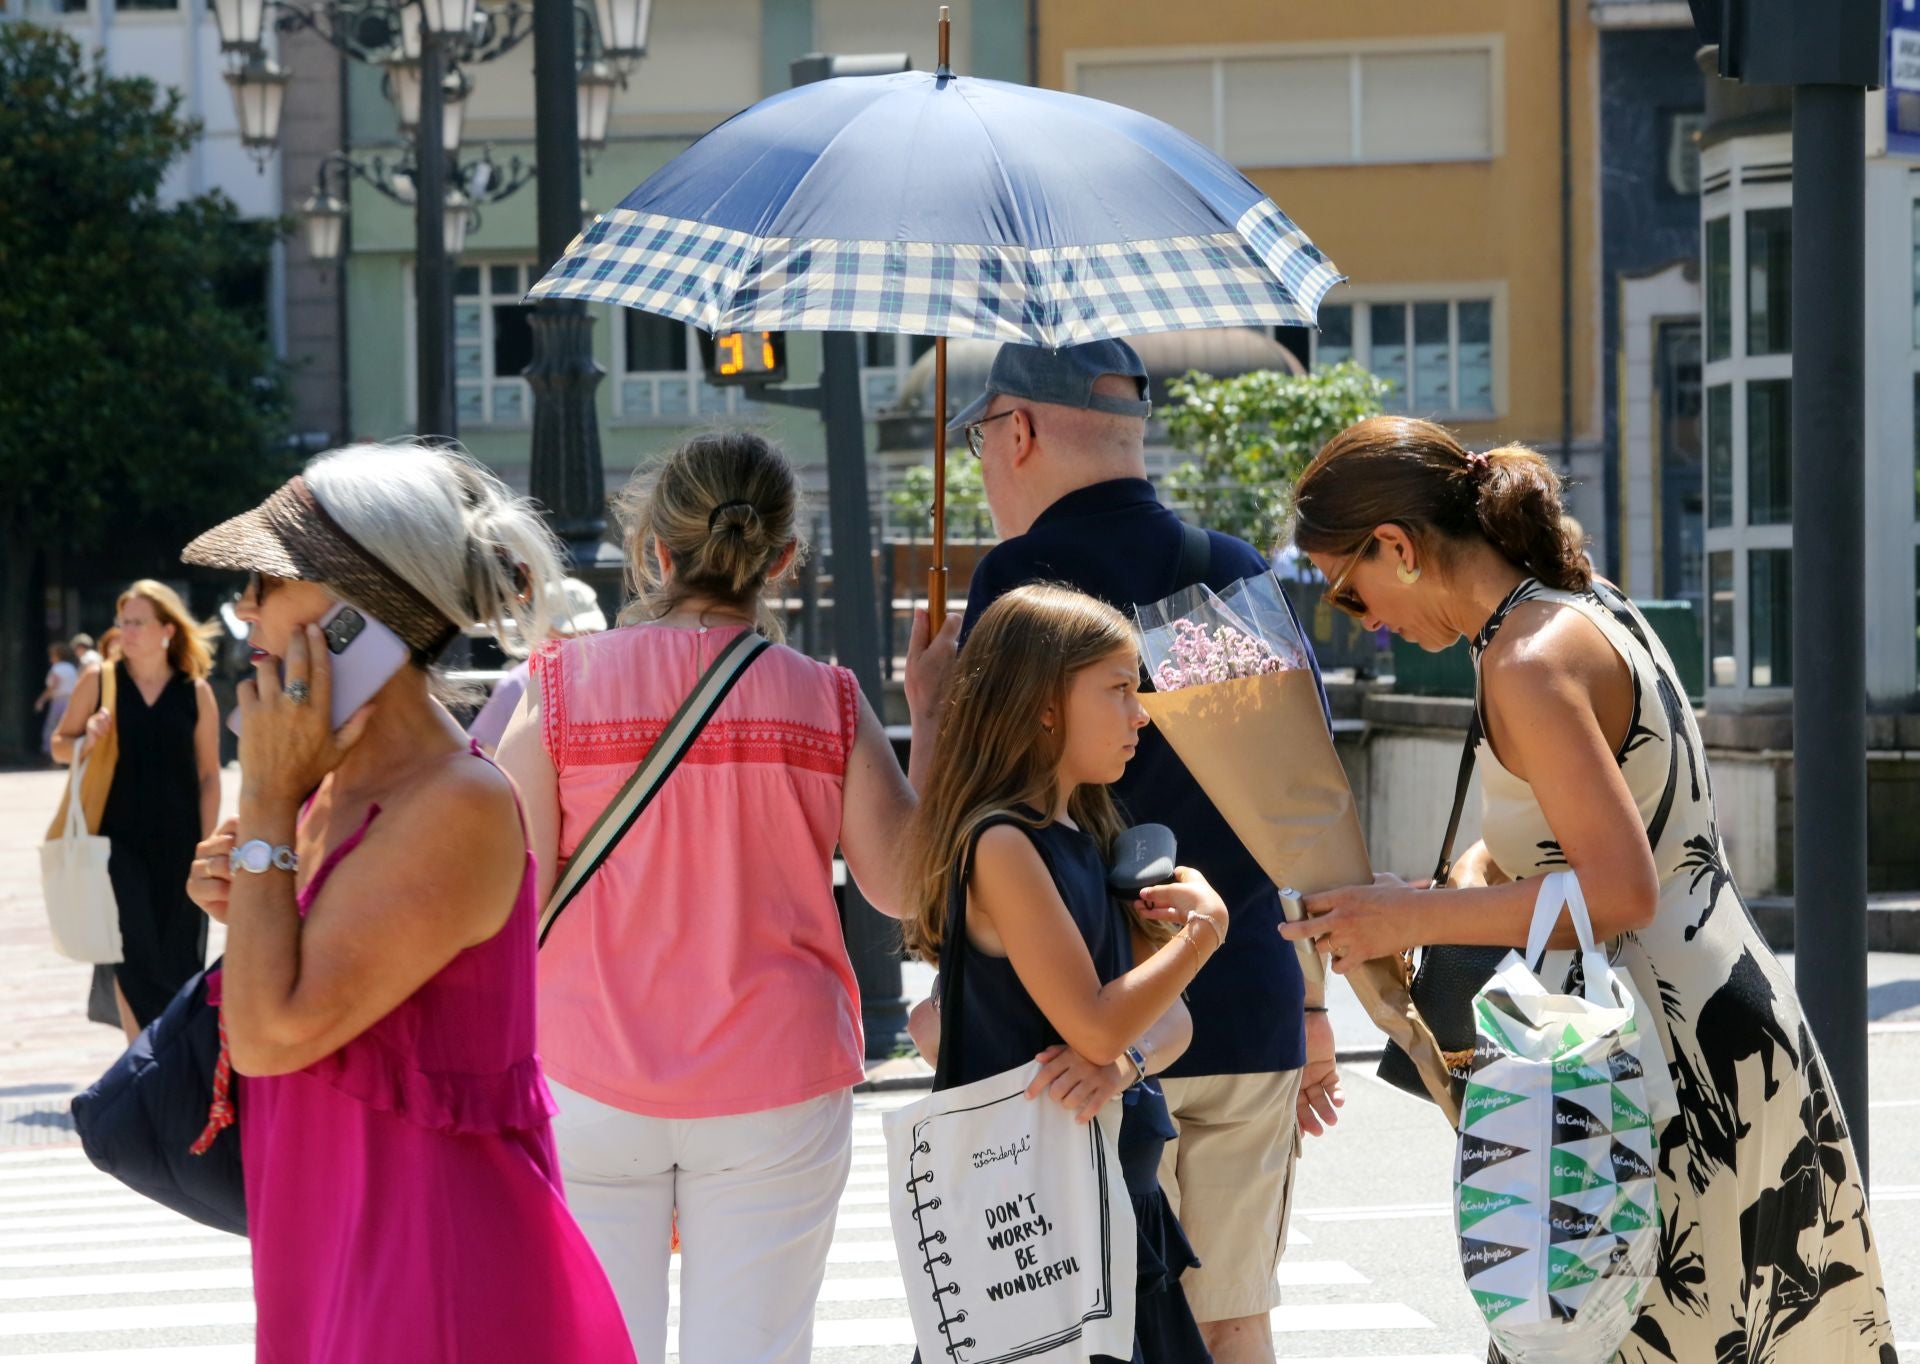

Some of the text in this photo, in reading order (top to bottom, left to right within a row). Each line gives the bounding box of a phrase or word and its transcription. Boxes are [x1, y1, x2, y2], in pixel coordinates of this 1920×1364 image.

[985, 1193, 1036, 1230] DON'T
[987, 1214, 1053, 1251] WORRY,
[1015, 1244, 1039, 1271] BE
[986, 1256, 1081, 1302] WONDERFUL
